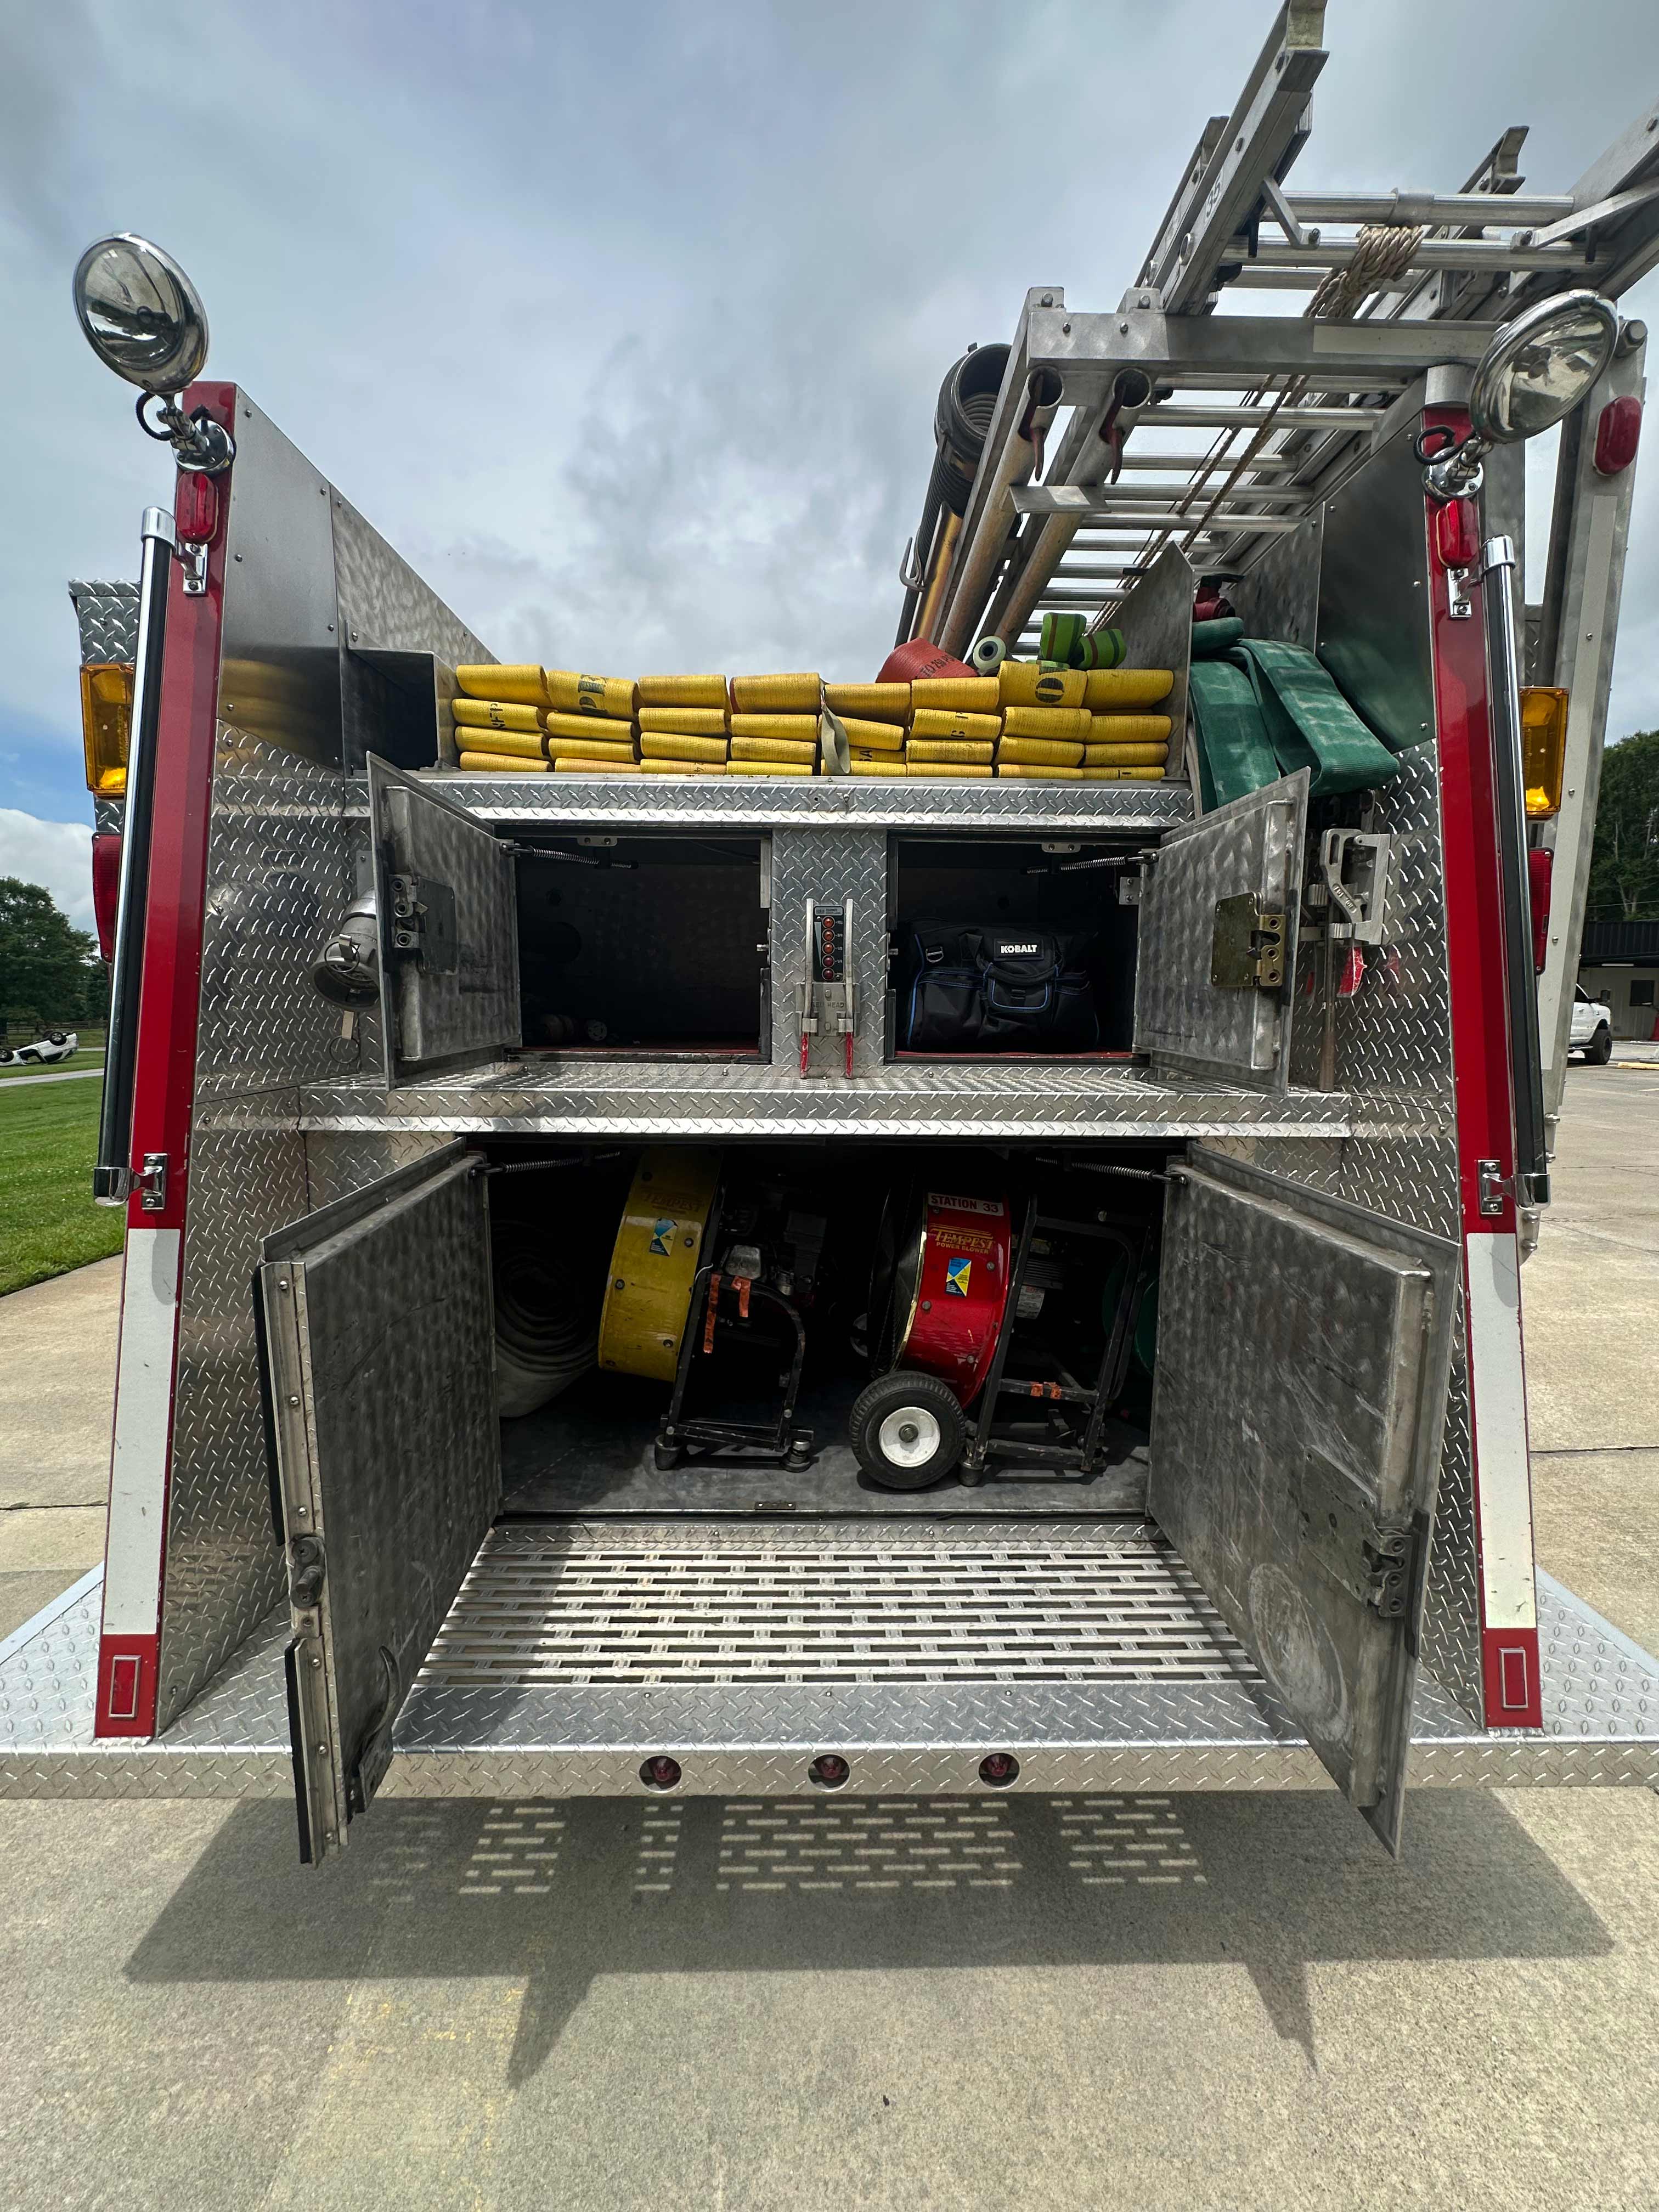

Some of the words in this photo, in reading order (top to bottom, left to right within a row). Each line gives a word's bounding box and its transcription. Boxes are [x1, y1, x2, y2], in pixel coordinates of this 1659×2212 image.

[1206, 171, 1221, 218] 35
[1001, 944, 1037, 953] KOBALT
[642, 1192, 704, 1212] TEMPEST
[931, 1195, 978, 1210] STATION
[983, 1203, 998, 1213] 33
[934, 1229, 996, 1249] TEMPEST
[961, 1245, 990, 1255] BLOWER
